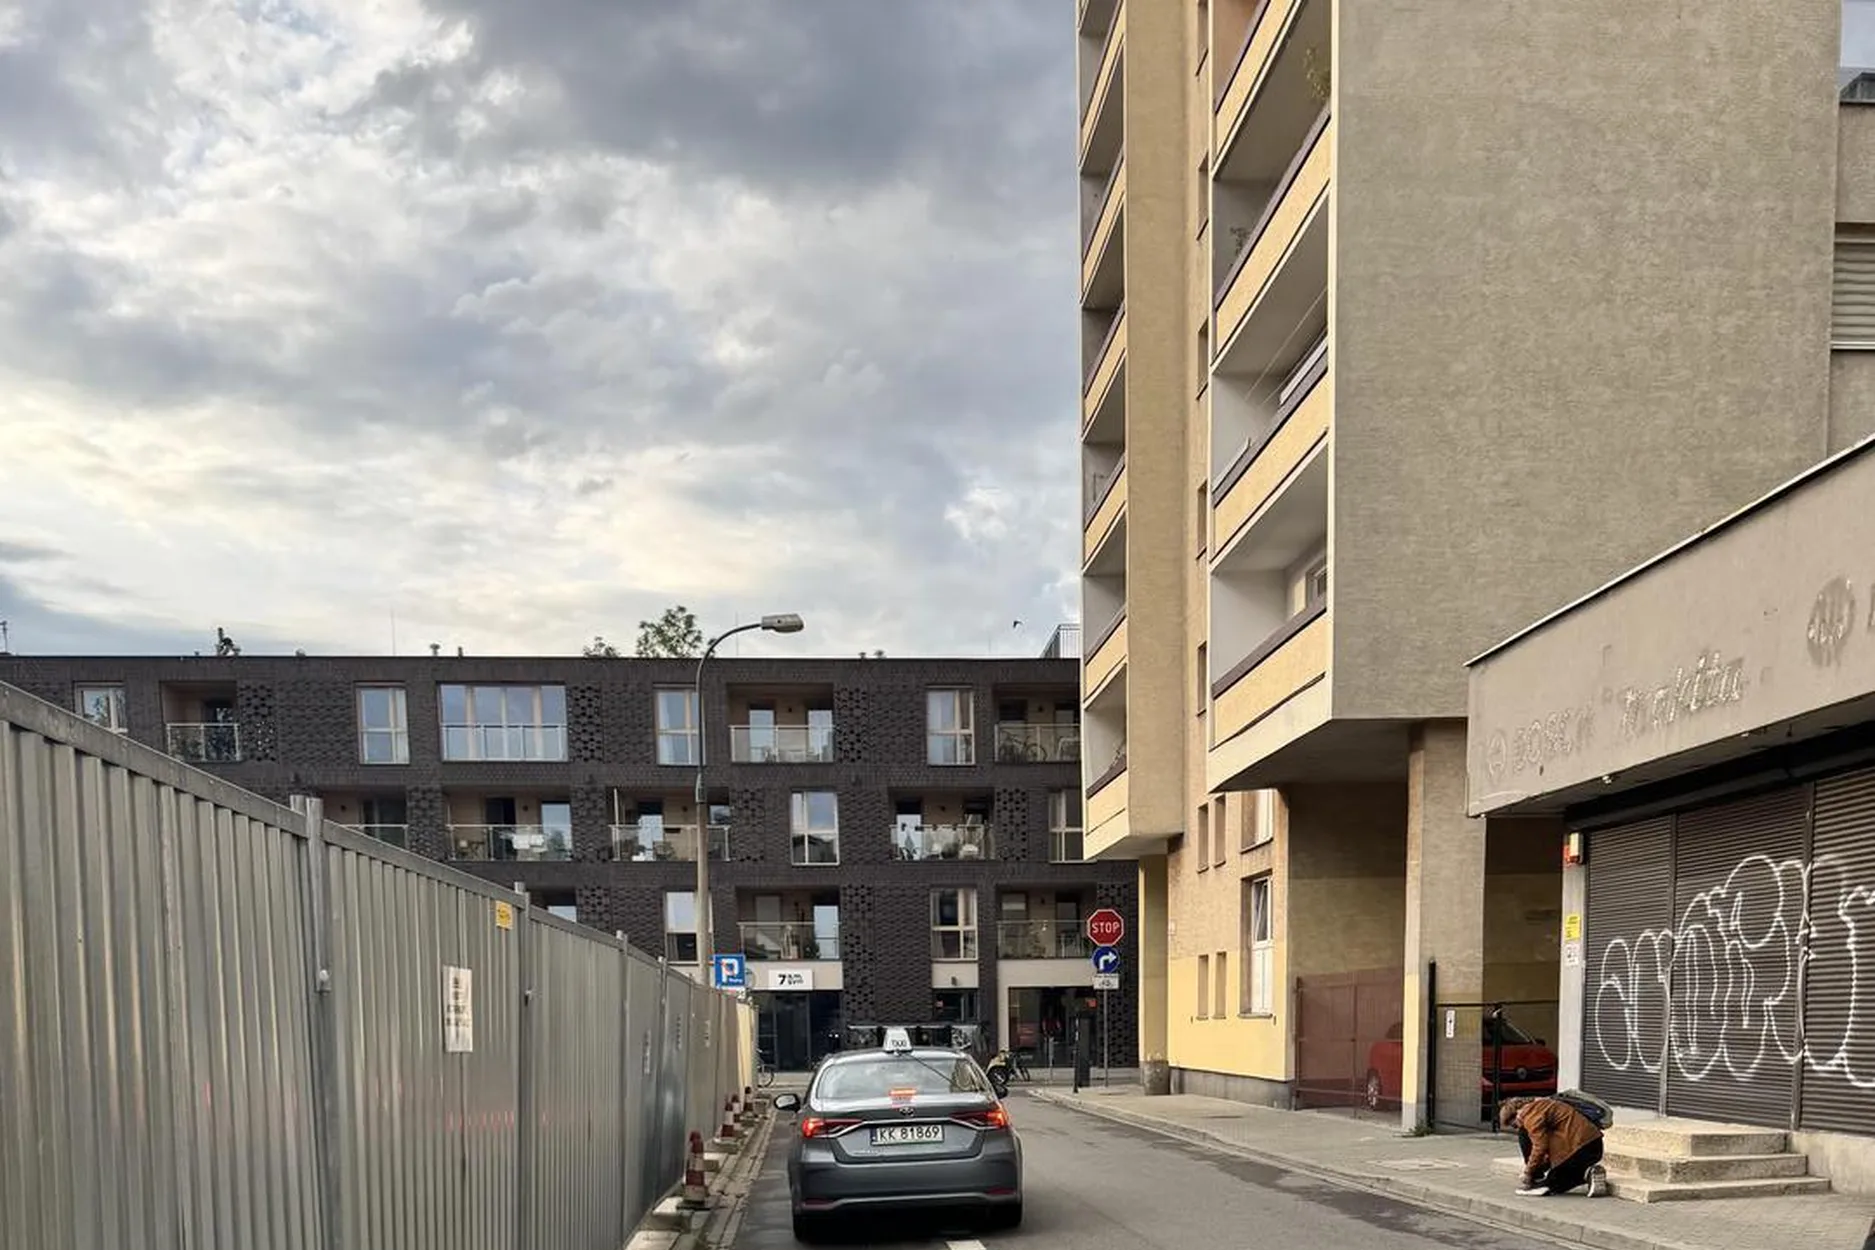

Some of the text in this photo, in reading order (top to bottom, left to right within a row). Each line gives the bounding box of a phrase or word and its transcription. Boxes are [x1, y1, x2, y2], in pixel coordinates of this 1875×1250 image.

[1091, 921, 1120, 934] STOP
[721, 958, 739, 983] P
[777, 973, 787, 986] 7
[891, 1039, 907, 1048] TAXI
[880, 1125, 940, 1141] KK 81869
